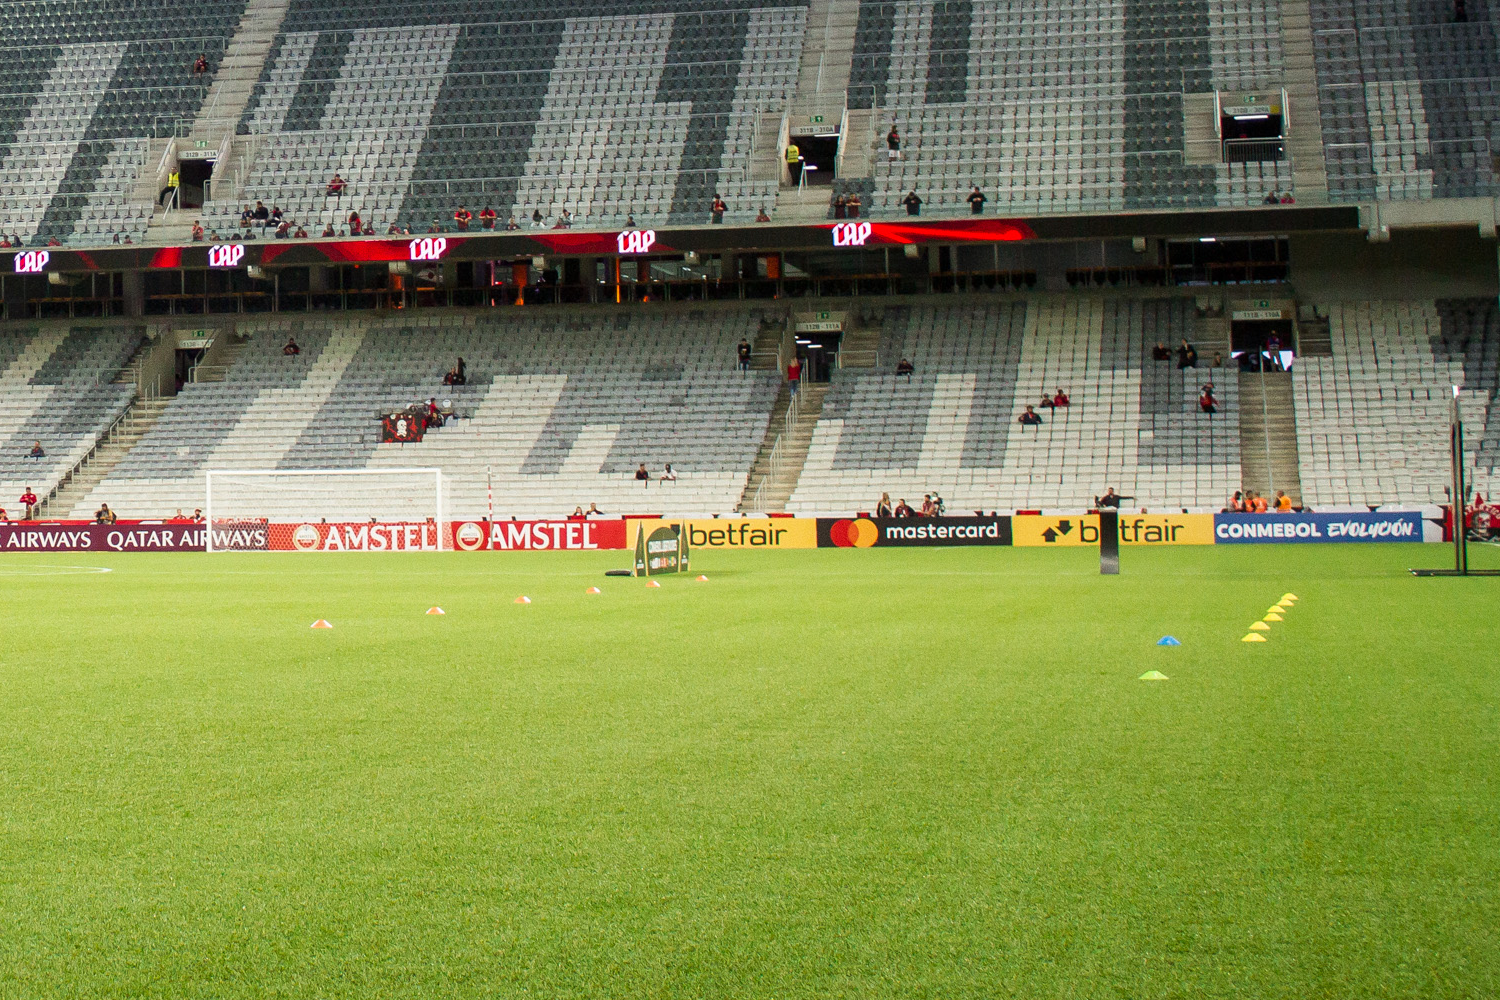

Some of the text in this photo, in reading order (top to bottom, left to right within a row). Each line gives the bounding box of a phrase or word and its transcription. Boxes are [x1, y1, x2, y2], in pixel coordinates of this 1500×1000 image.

[6, 531, 91, 548] AIRWAYS
[106, 529, 266, 551] QATAR AIRWAYS
[322, 525, 437, 550] AMSTEL
[486, 523, 598, 549] AMSTEL
[690, 522, 787, 546] betfair
[886, 522, 998, 540] mastercard
[1080, 519, 1185, 543] btfair
[1216, 522, 1321, 538] CONMEBOL
